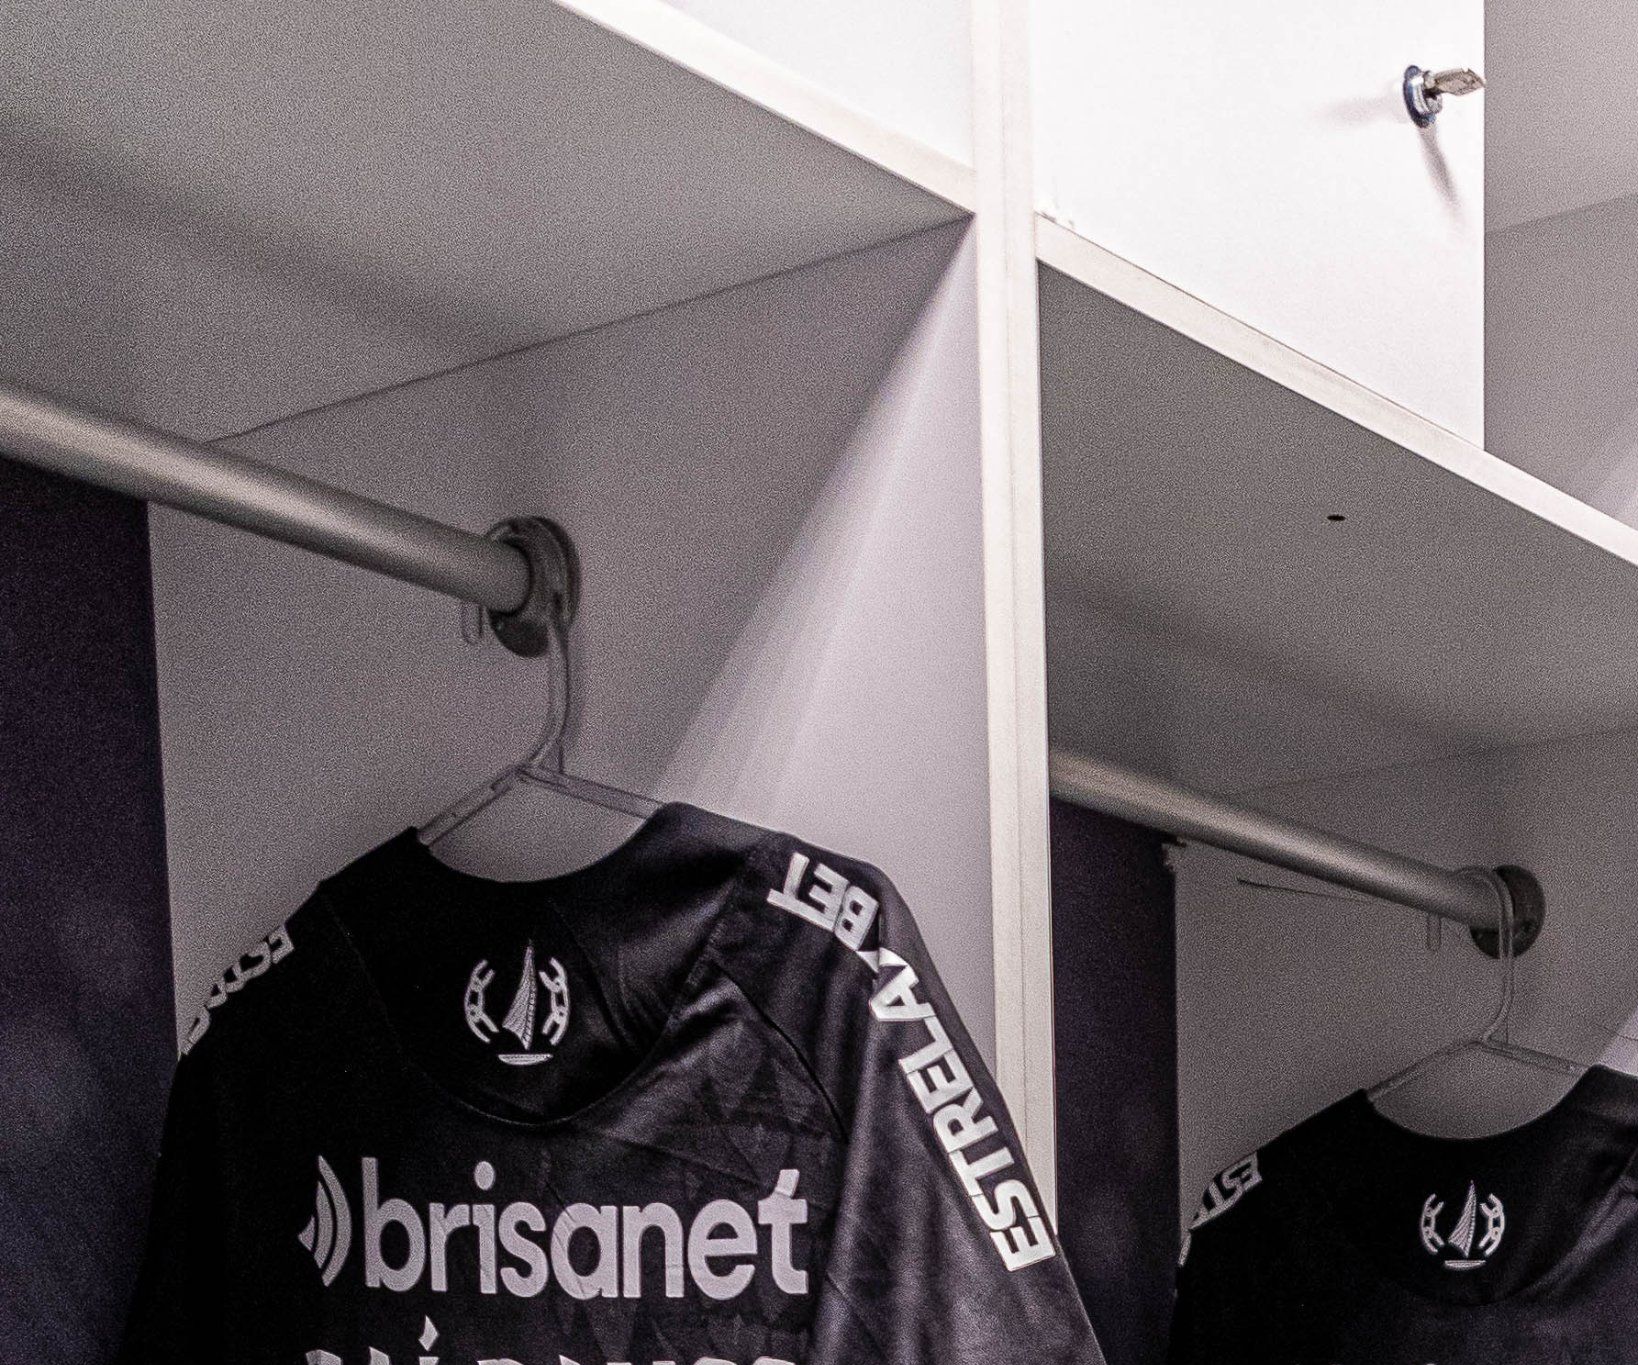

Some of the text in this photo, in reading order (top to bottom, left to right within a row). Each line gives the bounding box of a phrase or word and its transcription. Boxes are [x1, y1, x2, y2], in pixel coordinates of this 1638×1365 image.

[767, 852, 1057, 1273] ESTRELA BET
[362, 1157, 808, 1299] brisanet
